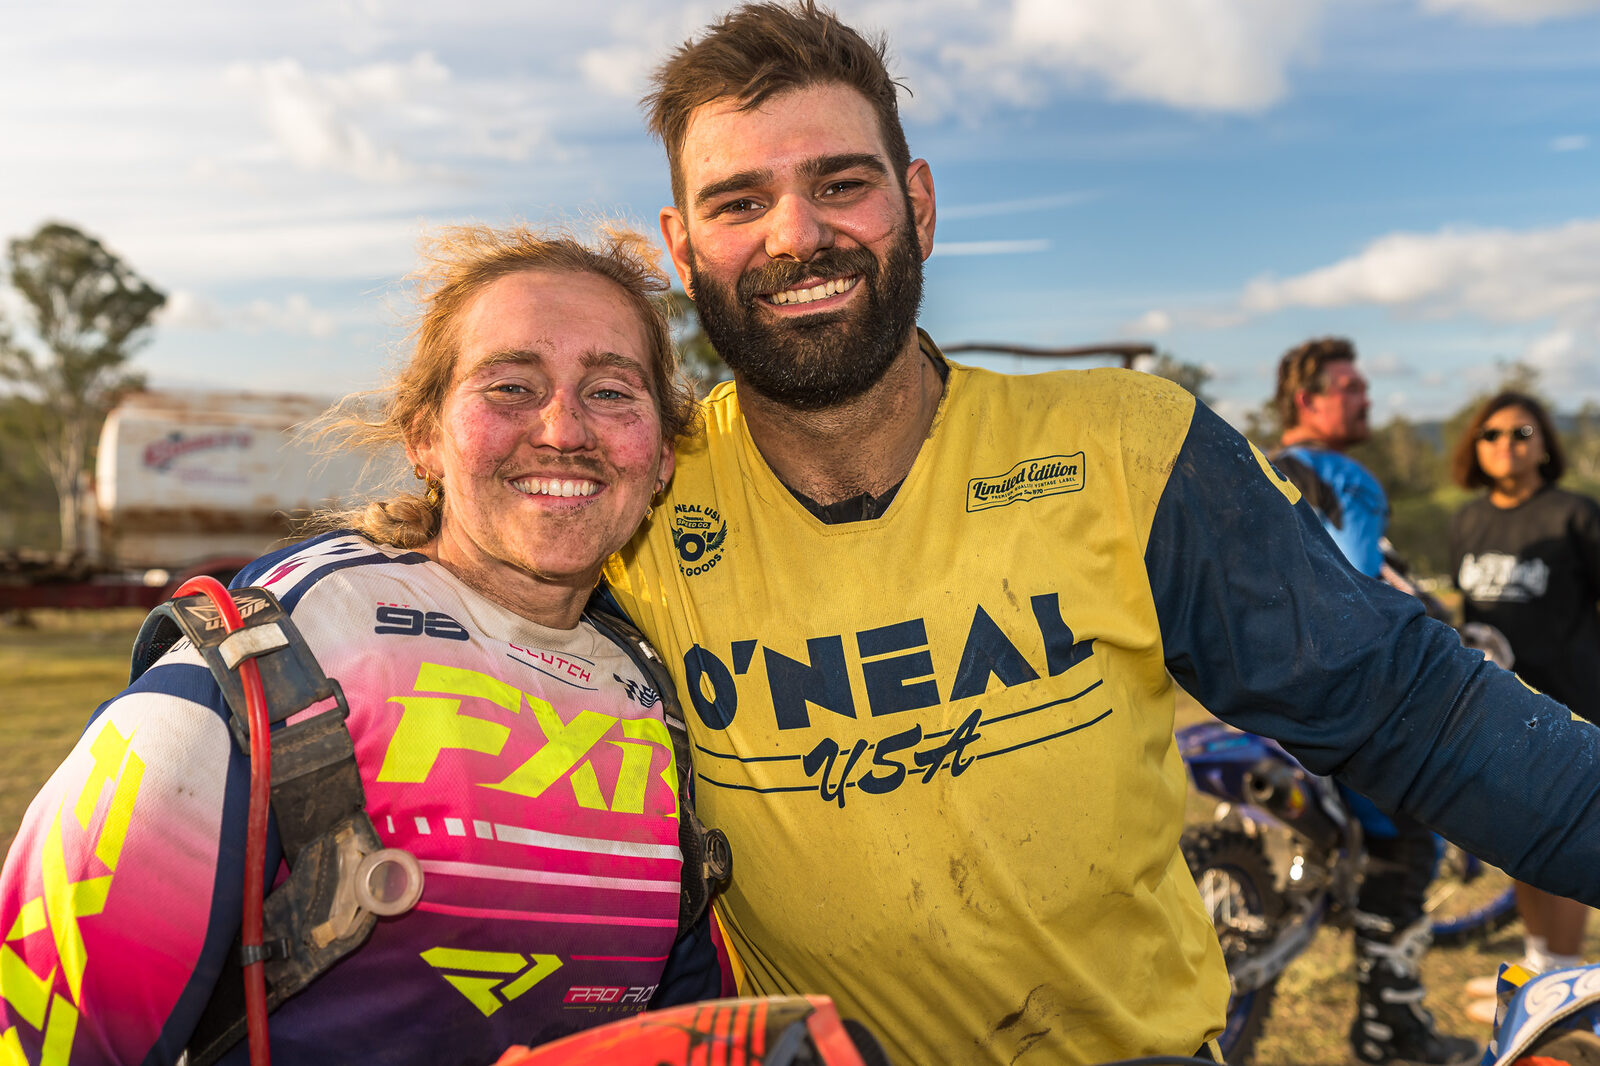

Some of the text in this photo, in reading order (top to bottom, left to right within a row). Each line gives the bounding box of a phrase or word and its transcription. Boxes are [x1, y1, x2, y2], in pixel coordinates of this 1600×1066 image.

[973, 467, 1026, 501] Limited
[1027, 462, 1078, 482] Edition
[1035, 480, 1057, 488] VINTAGE
[686, 553, 722, 577] GOODS
[684, 592, 1097, 731] O'NEAL
[376, 661, 681, 822] FXR
[802, 708, 984, 809] USA
[569, 987, 621, 1002] PRO
[588, 1004, 648, 1013] DIVISIO
